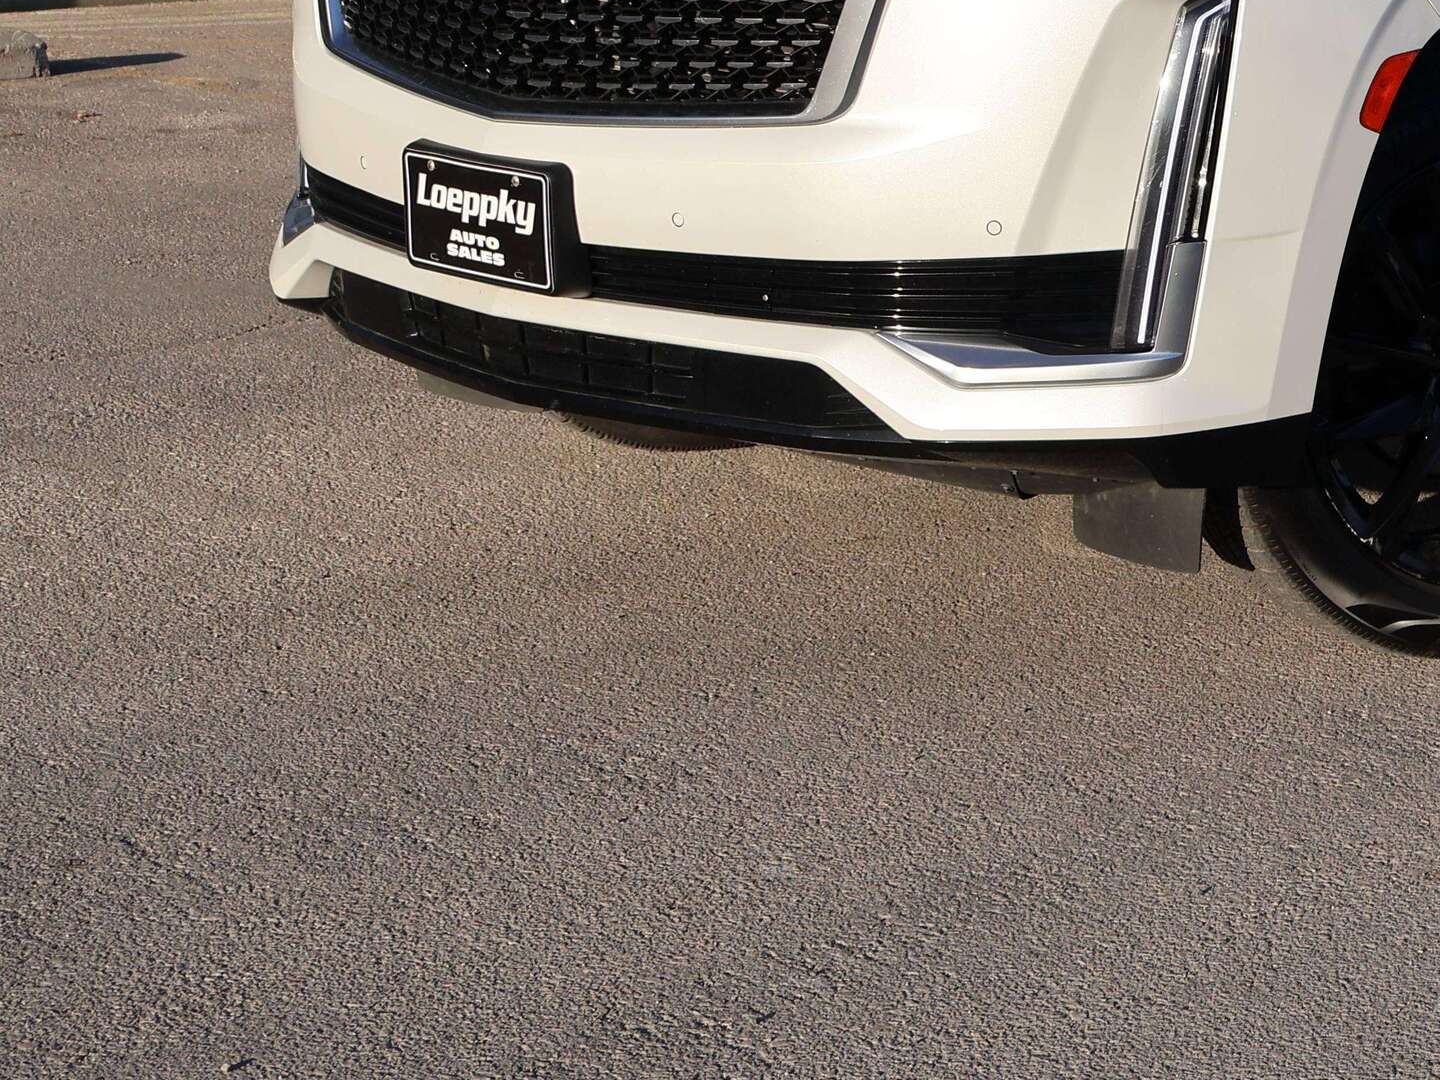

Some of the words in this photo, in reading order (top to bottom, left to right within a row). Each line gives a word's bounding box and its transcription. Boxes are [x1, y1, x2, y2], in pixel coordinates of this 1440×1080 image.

[416, 172, 537, 237] Loeppky
[449, 228, 500, 251] AUTO
[446, 242, 506, 267] SALES
